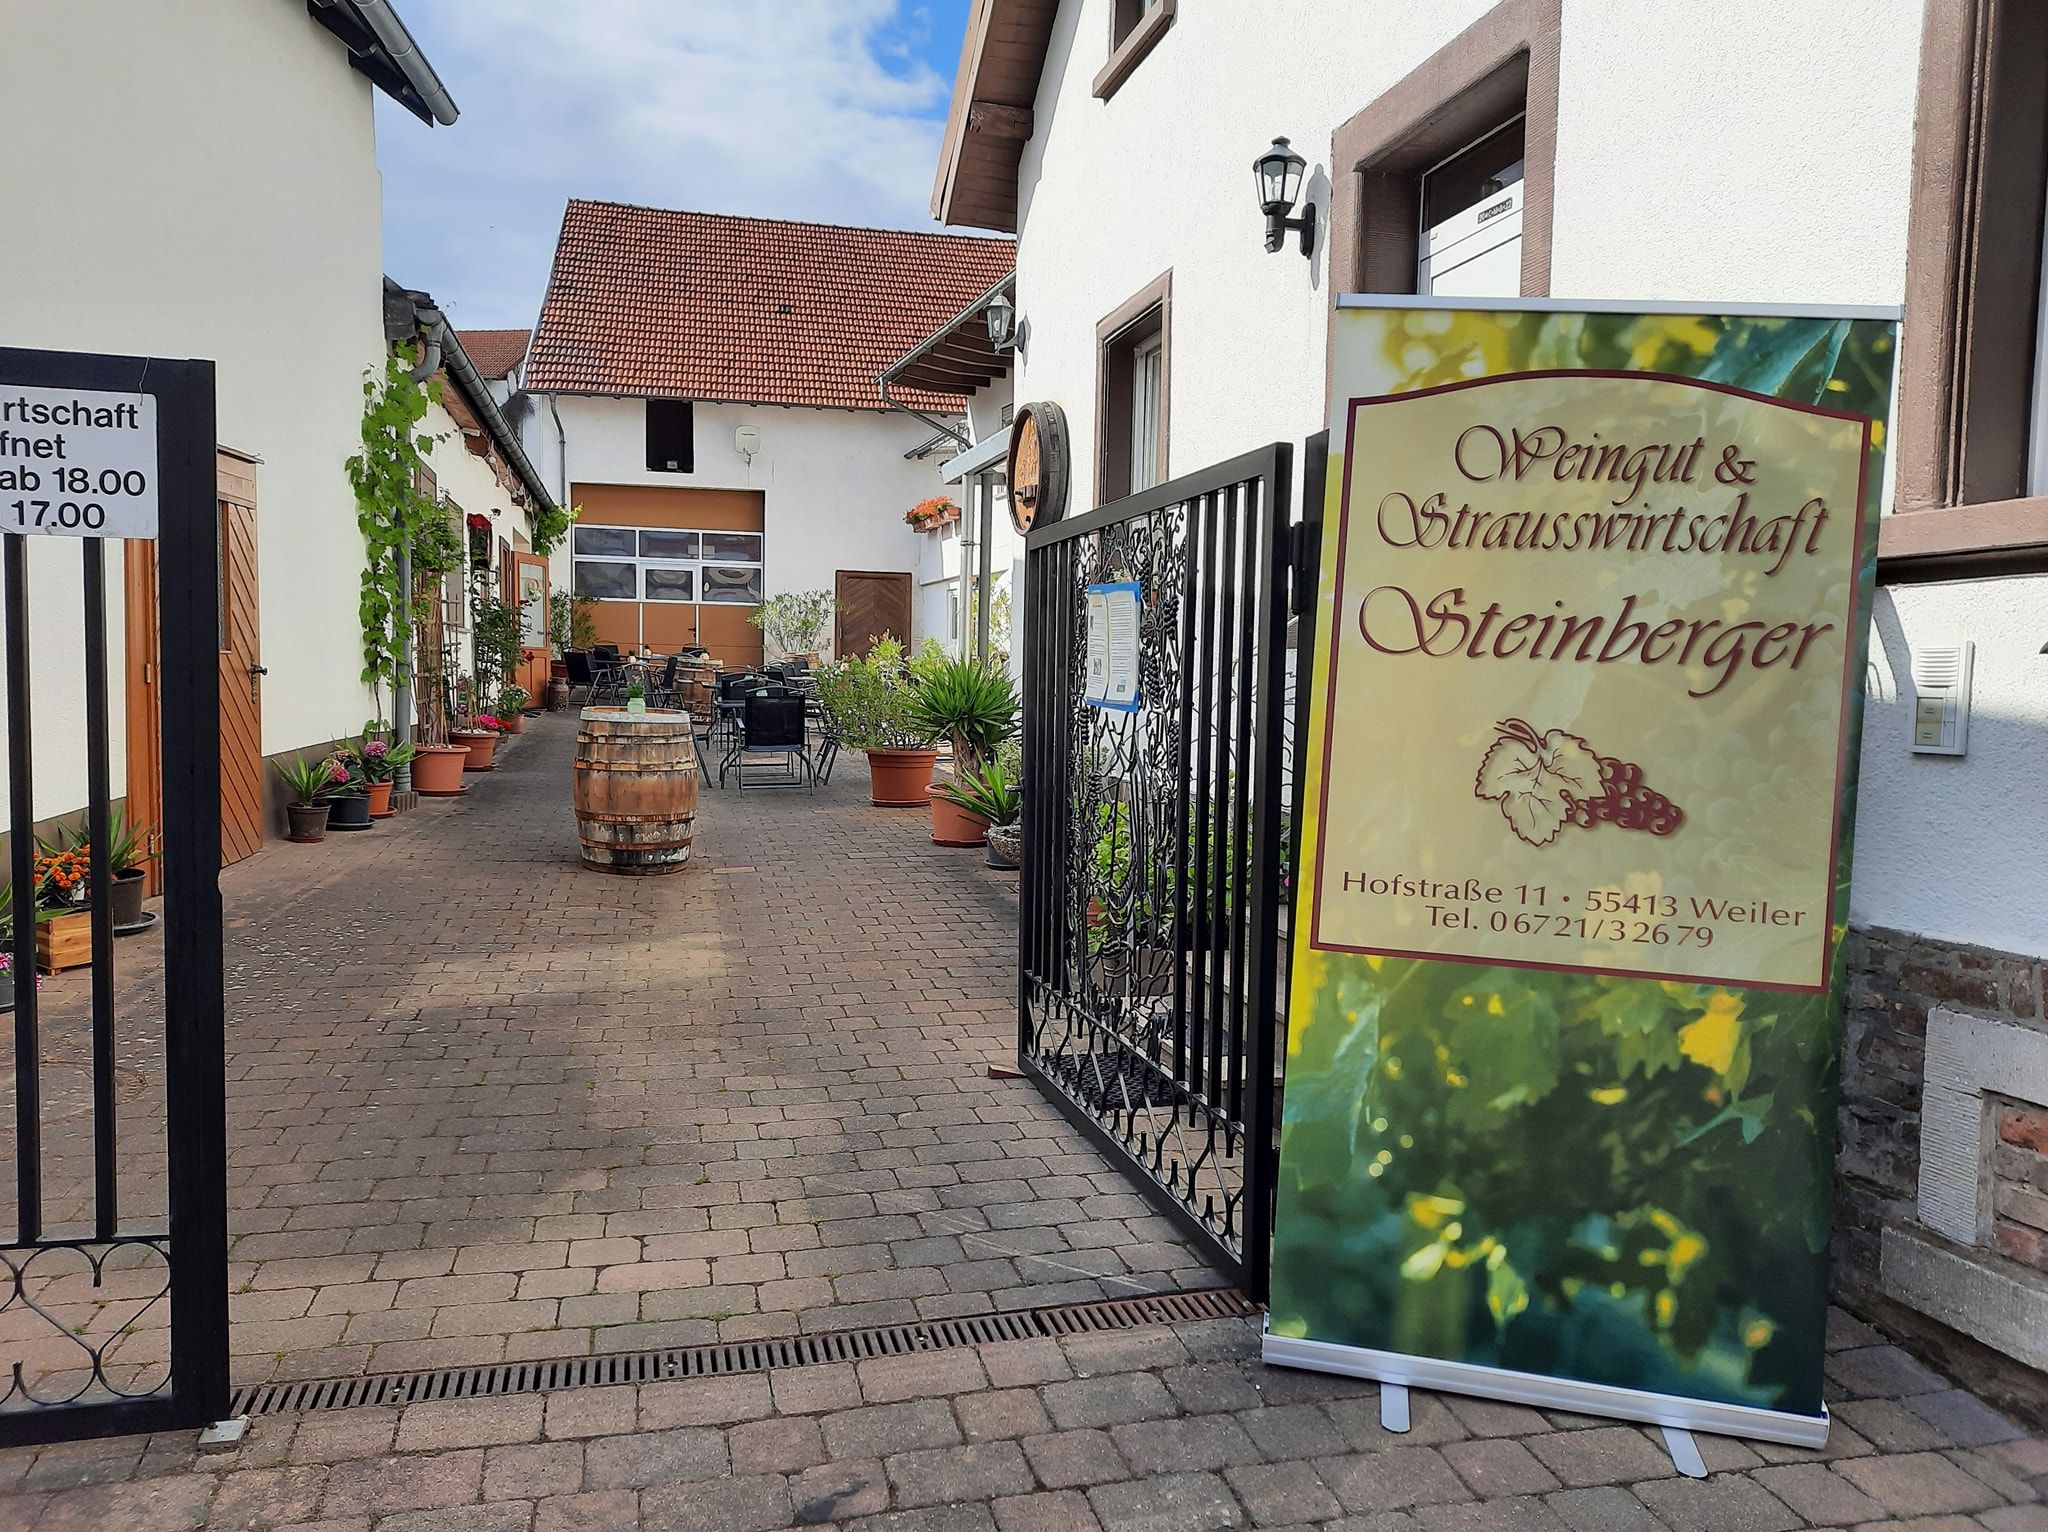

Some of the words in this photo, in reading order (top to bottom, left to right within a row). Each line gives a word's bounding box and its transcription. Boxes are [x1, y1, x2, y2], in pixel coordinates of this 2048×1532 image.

[0, 430, 67, 460] fnet
[1454, 424, 1704, 508] Weingut
[1714, 443, 1758, 486] &
[0, 465, 41, 492] ab
[51, 466, 146, 497] 18.00
[10, 499, 106, 530] 17.00
[1377, 491, 1831, 578] Strausswirtschaft
[1358, 585, 1835, 700] Steinberger
[1342, 870, 1504, 904] Hofstraße
[1514, 883, 1548, 908] 11
[1584, 890, 1679, 919] 55413
[1690, 896, 1808, 927] Weiler
[1424, 904, 1479, 931] Tel.
